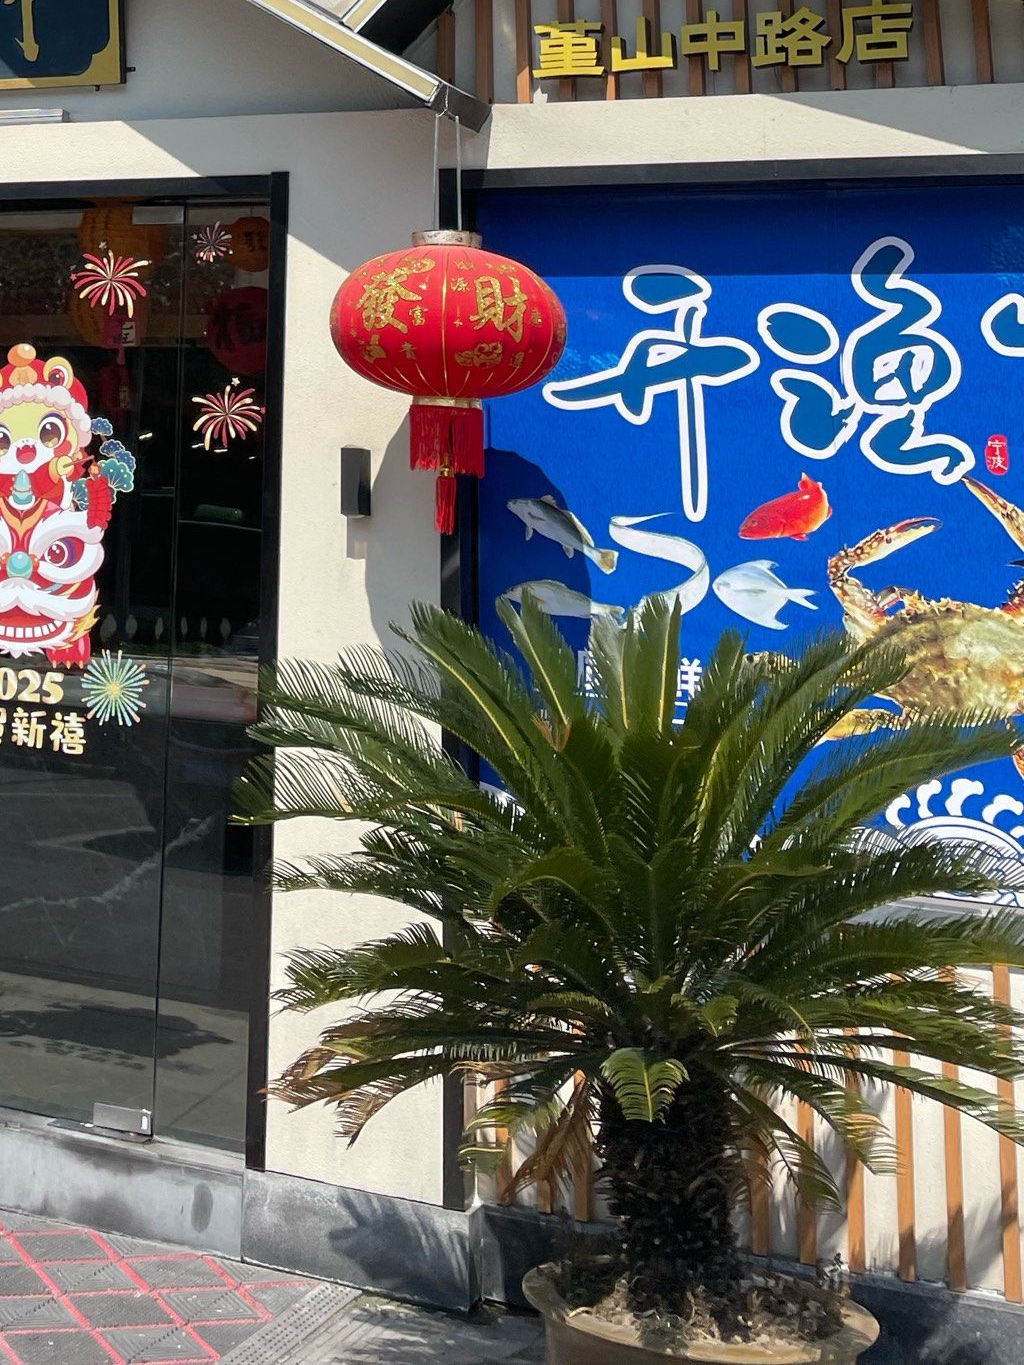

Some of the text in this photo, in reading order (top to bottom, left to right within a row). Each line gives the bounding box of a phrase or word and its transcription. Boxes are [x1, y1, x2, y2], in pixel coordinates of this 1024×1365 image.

[355, 267, 528, 344] 發財
[543, 236, 1024, 523] 开渔
[986, 438, 1008, 471] 宁波
